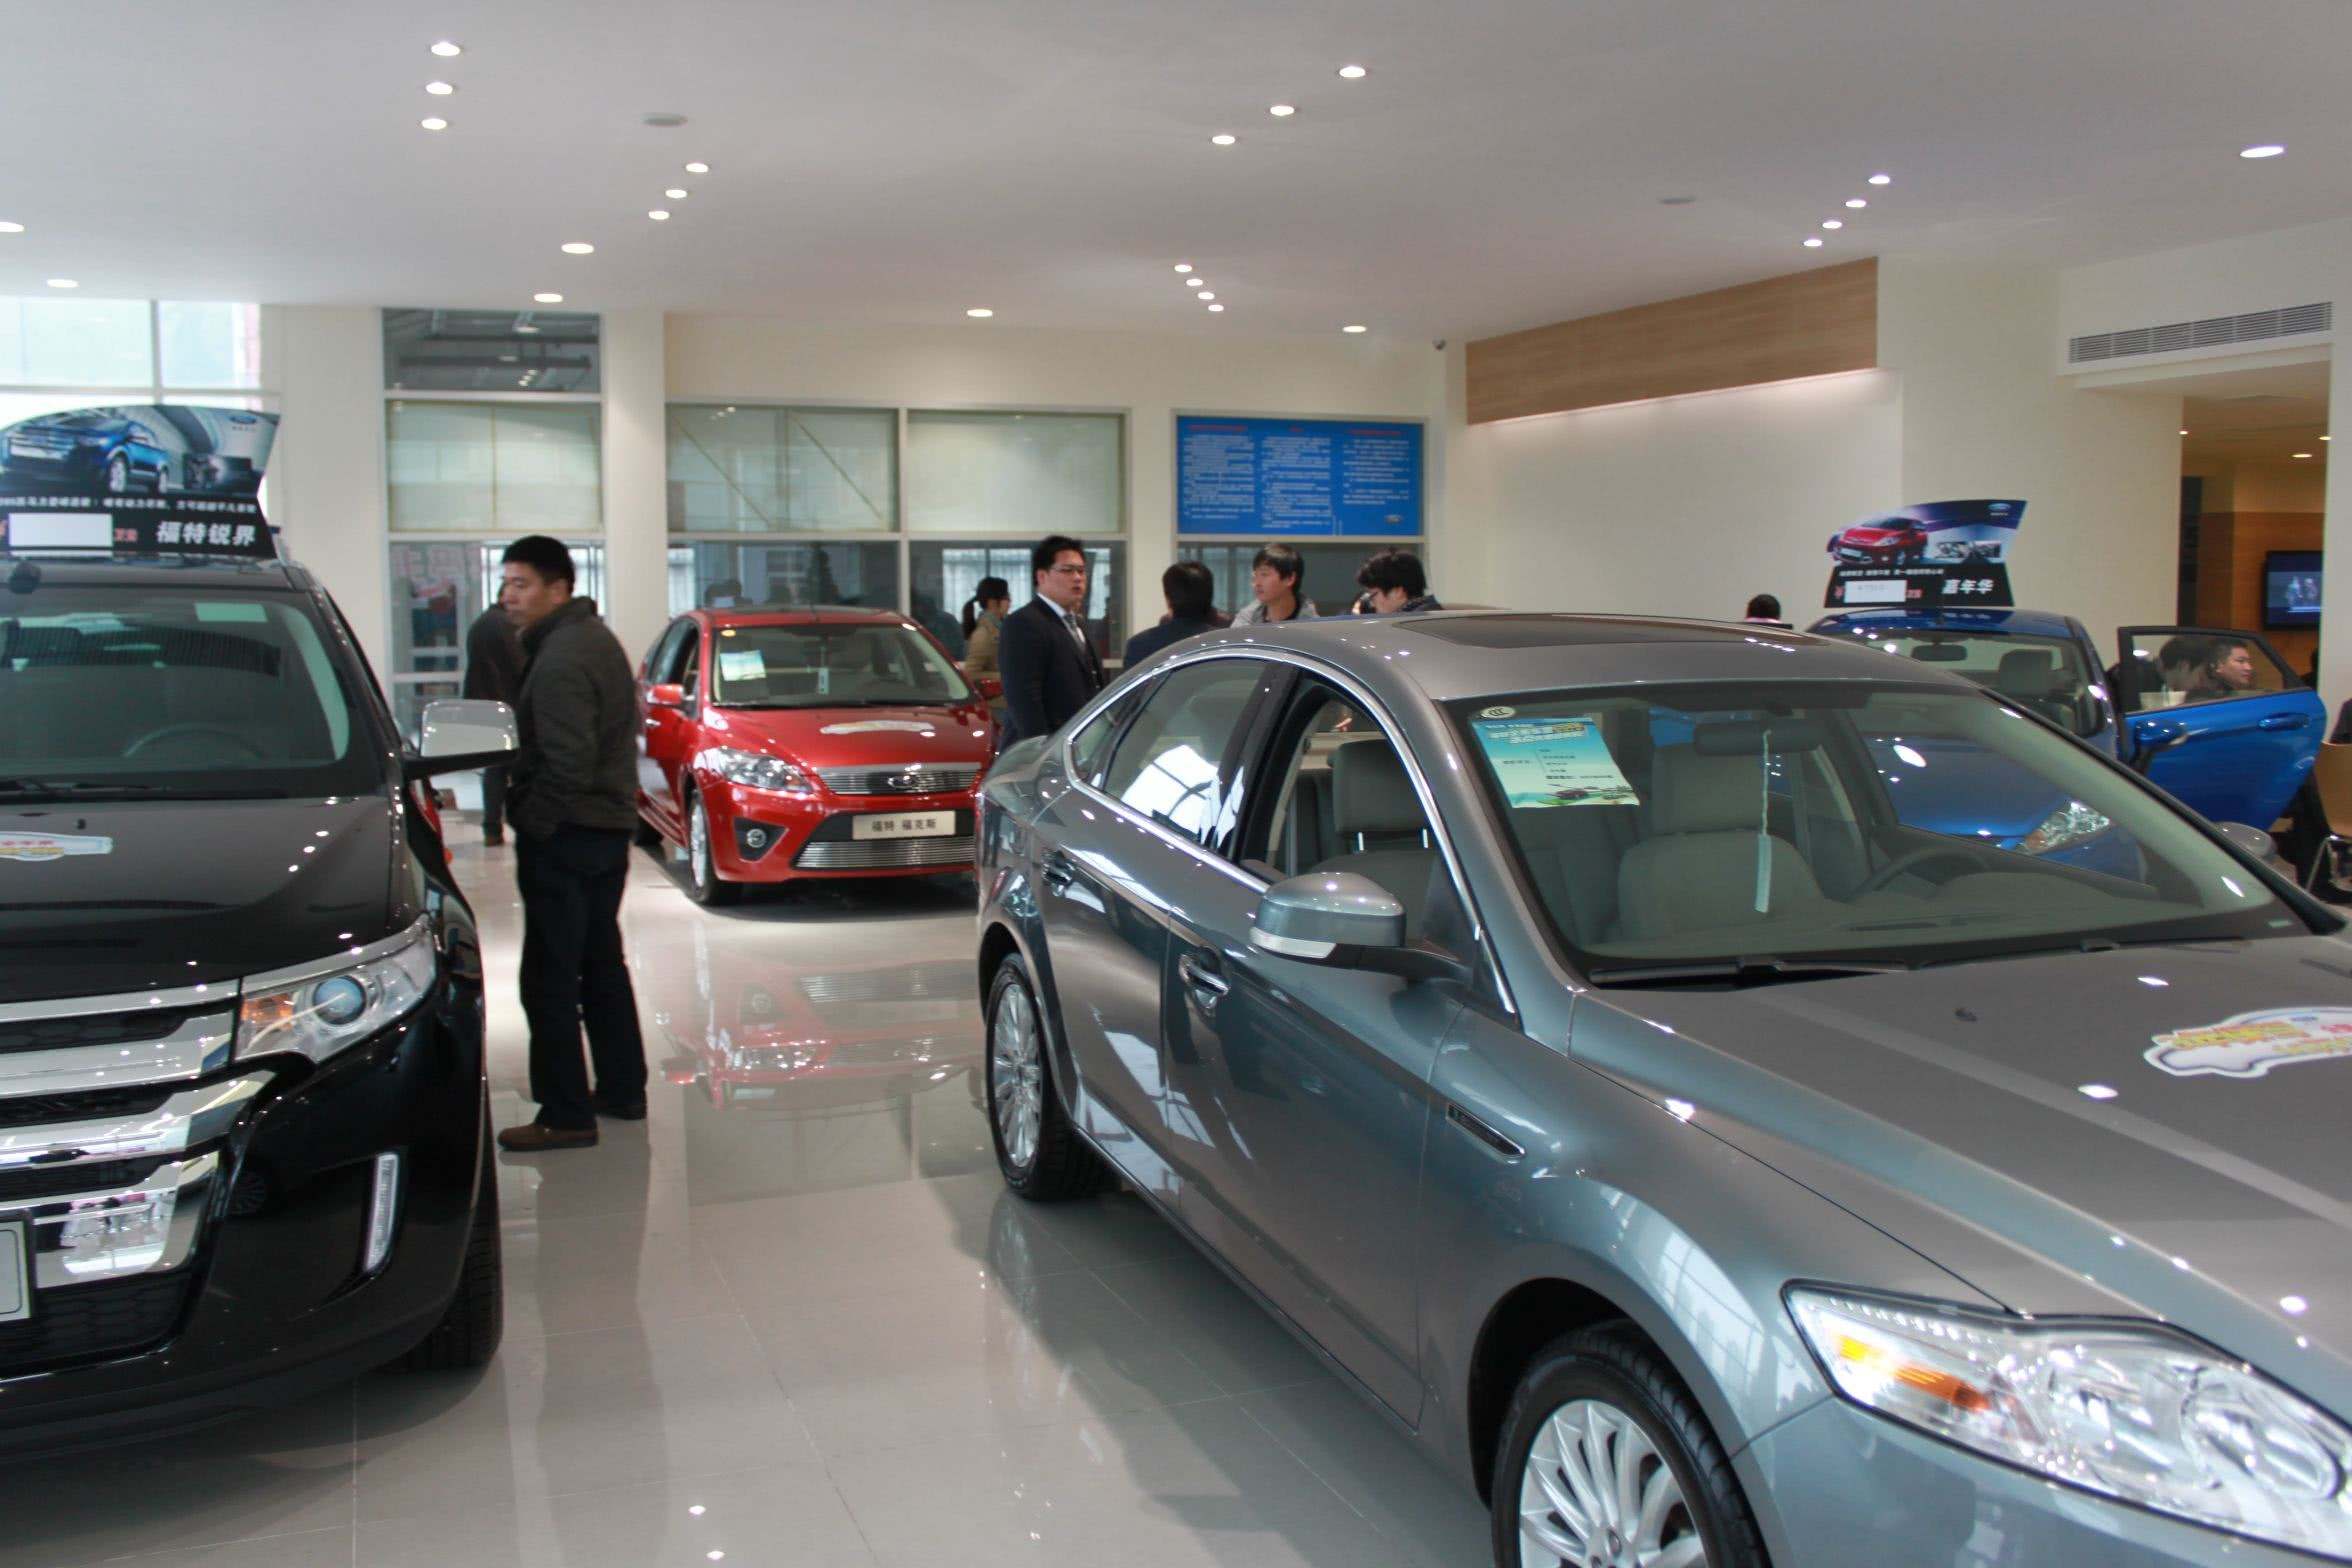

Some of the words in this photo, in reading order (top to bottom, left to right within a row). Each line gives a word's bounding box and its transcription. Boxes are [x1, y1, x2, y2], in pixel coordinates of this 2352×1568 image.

[156, 521, 255, 546] 福特锐界
[1941, 578, 1994, 594] 嘉年华
[872, 820, 895, 832] 福特
[902, 818, 937, 831] 福克斯
